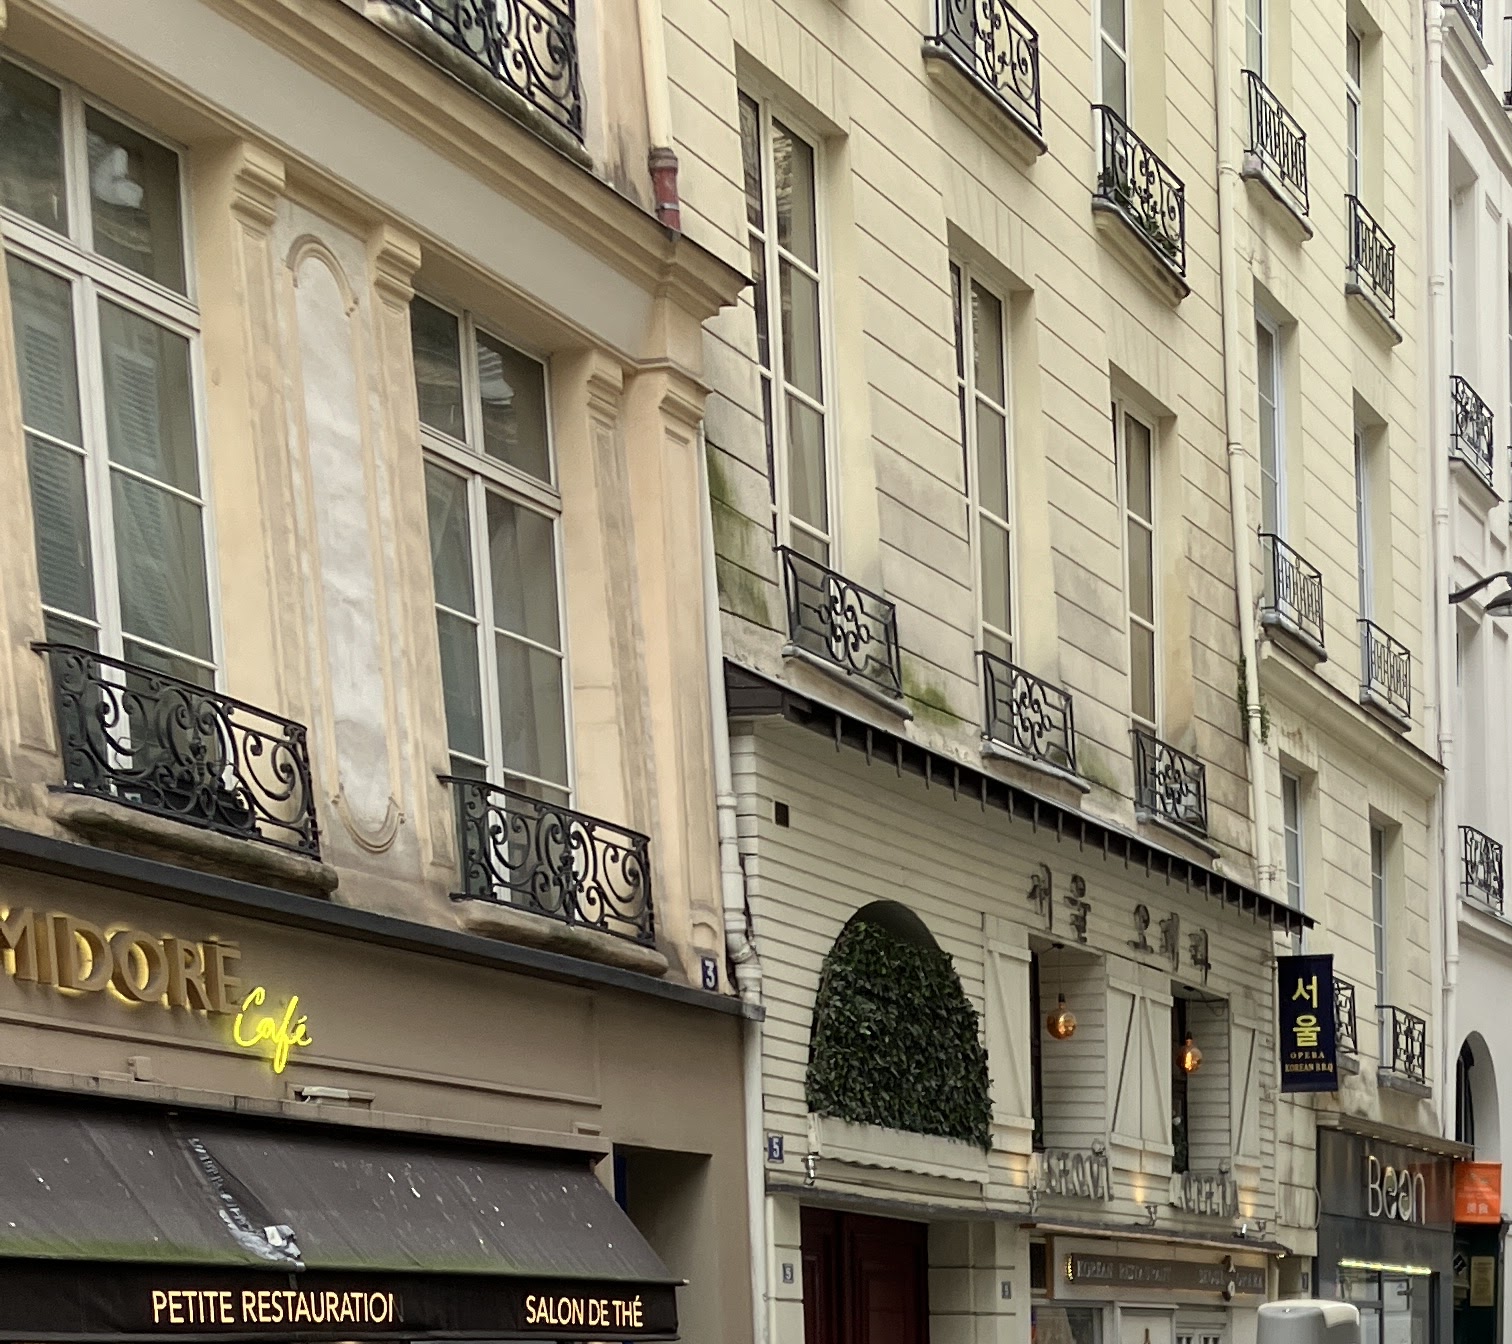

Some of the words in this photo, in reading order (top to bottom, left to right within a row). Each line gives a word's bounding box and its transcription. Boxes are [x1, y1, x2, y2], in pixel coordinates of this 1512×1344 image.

[704, 958, 715, 989] 3
[1292, 975, 1321, 1047] 서울
[233, 986, 313, 1074] Café
[1285, 1063, 1314, 1073] KOREAN
[1290, 1051, 1325, 1060] OPERA
[772, 1137, 781, 1159] 5
[1368, 1154, 1426, 1226] Bean
[151, 1290, 235, 1324] PETITE
[525, 1295, 584, 1325] SALON
[588, 1299, 610, 1327] DE
[612, 1295, 644, 1328] THÉ
